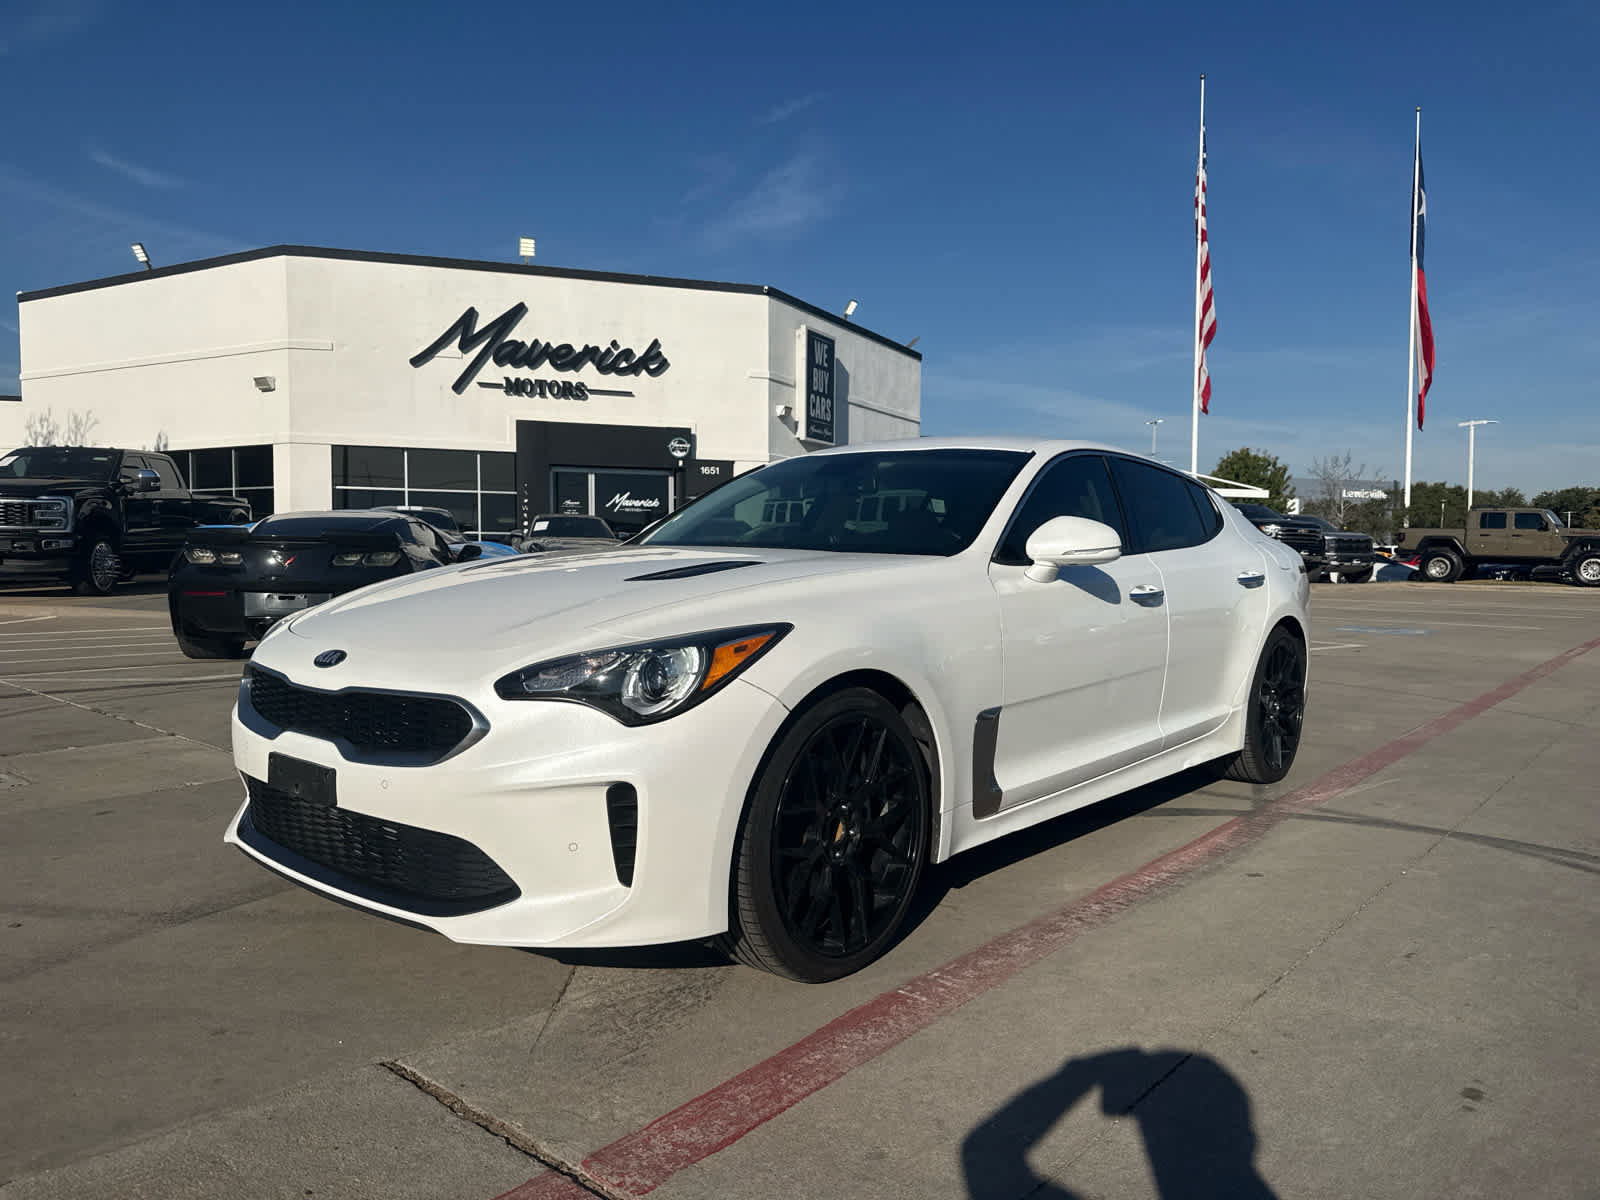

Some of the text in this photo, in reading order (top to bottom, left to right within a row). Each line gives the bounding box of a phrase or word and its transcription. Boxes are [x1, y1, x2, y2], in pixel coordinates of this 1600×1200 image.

[409, 301, 671, 395] Maverick
[814, 339, 829, 367] WE
[503, 376, 589, 401] MOTORS
[812, 367, 830, 394] BUY
[809, 393, 832, 422] CARS
[700, 466, 720, 475] 1651
[605, 491, 660, 512] Maverick
